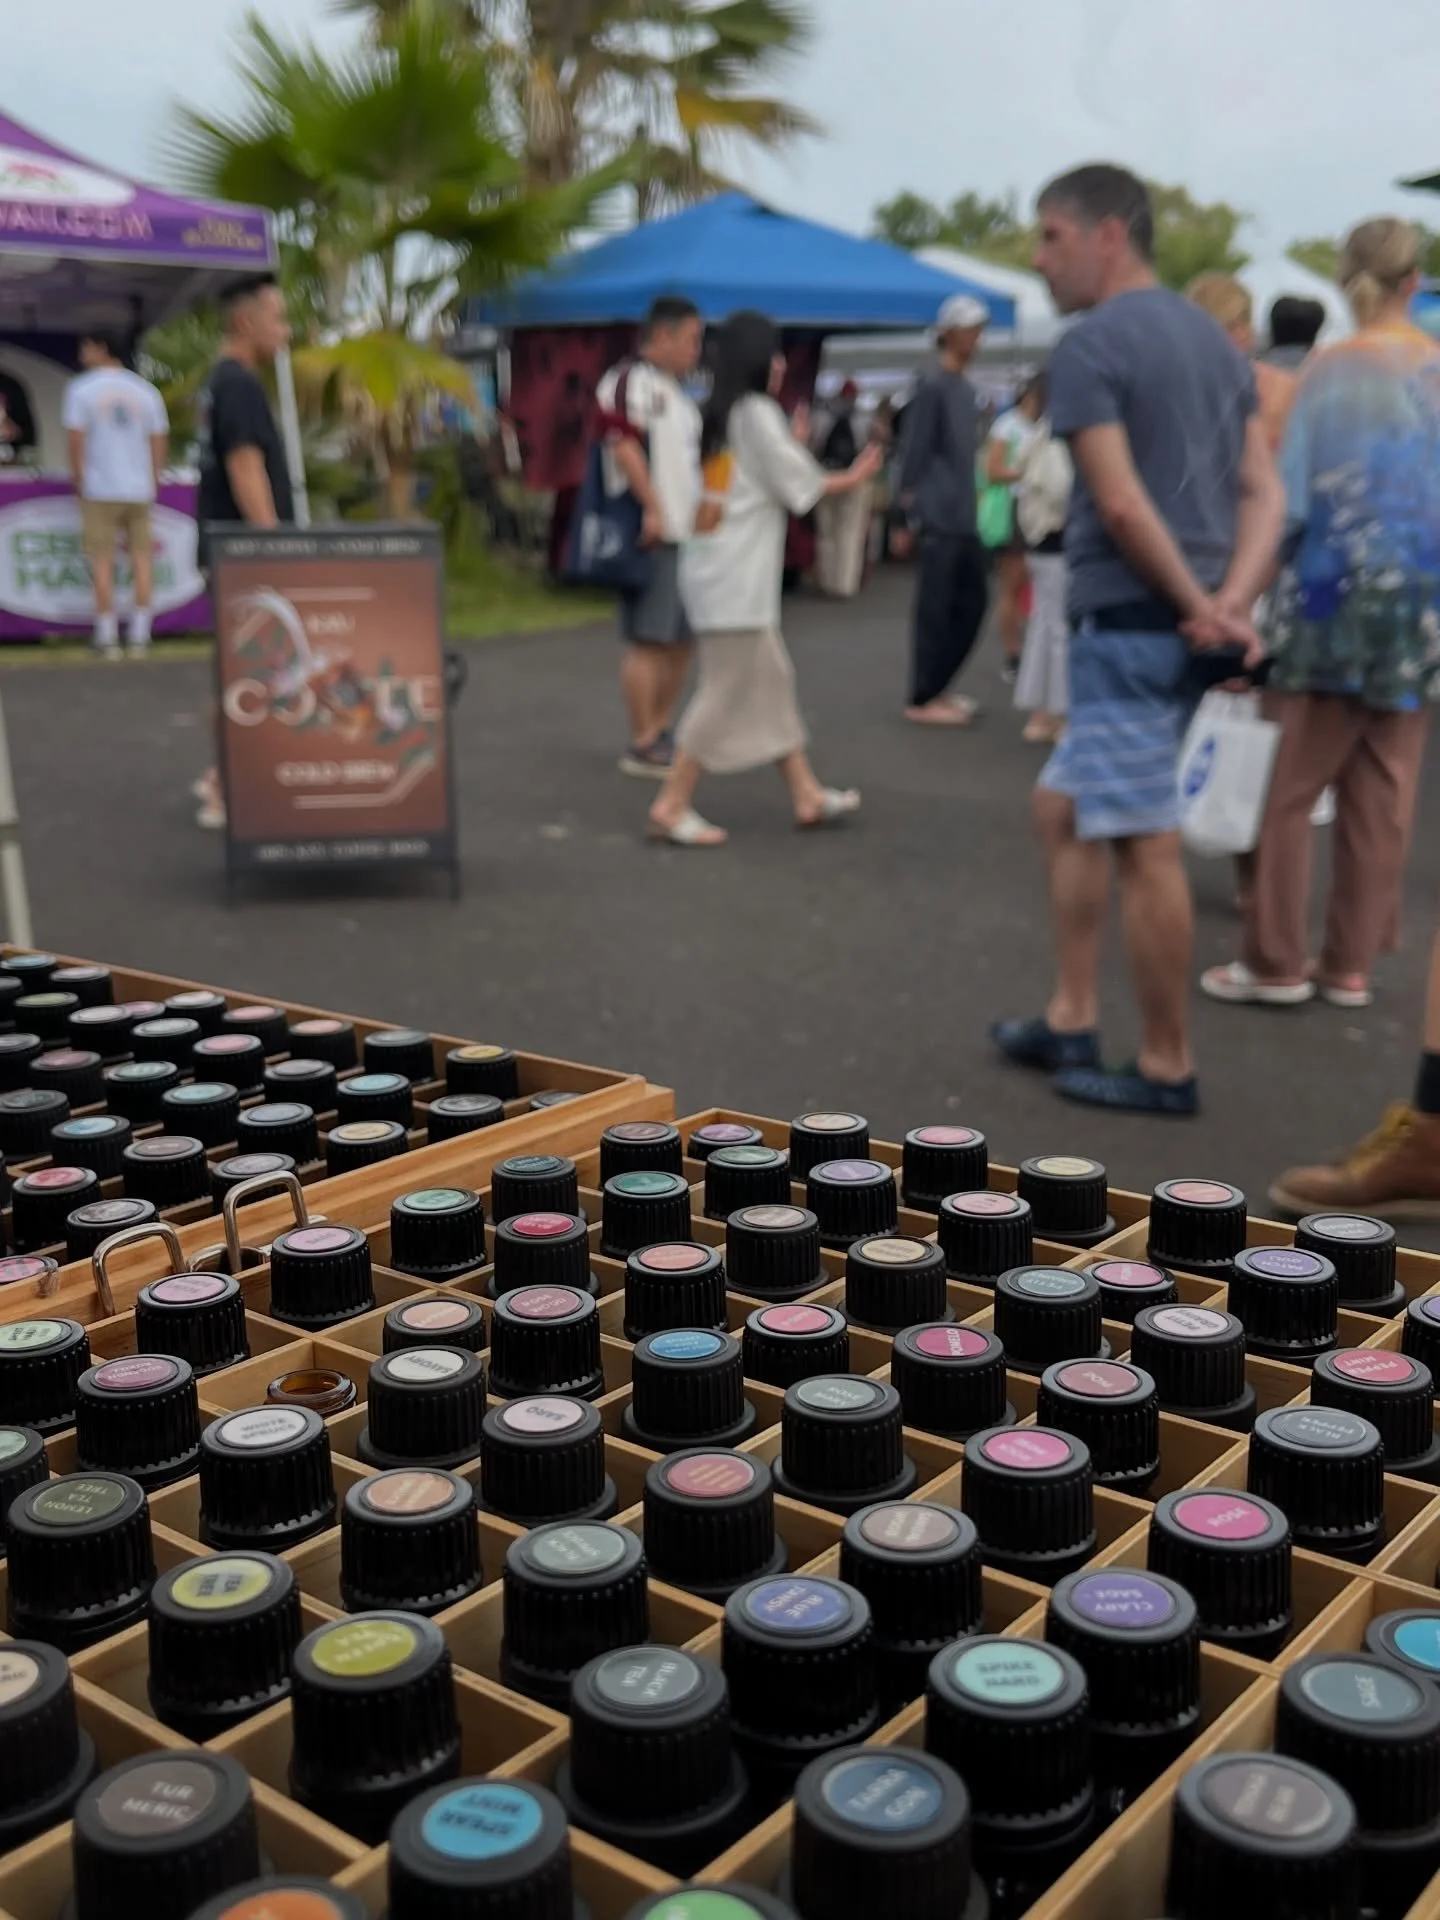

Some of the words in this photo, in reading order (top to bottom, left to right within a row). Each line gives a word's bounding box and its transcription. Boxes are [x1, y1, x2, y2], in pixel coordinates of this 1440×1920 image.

[946, 1328, 963, 1356] POMELO
[404, 1354, 455, 1375] SAVORY
[1344, 1355, 1377, 1367] MINT
[1345, 1361, 1398, 1376] PEPPER
[526, 1405, 570, 1422] SARO
[241, 1424, 297, 1440] SPRUCE
[242, 1418, 287, 1431] WHITE
[1298, 1422, 1342, 1440] BLACK
[1300, 1414, 1357, 1435] PEPPER
[68, 1493, 92, 1504] TEA
[77, 1483, 108, 1495] TREE
[44, 1500, 93, 1514] LEMON
[1206, 1506, 1250, 1528] ROSE
[546, 1539, 579, 1561] BLACK
[765, 1585, 805, 1612] TANSY
[1095, 1588, 1143, 1599] SAGE
[785, 1595, 824, 1618] BLUE
[1094, 1601, 1153, 1612] CLARY
[620, 1665, 648, 1687] TEA
[977, 1660, 1036, 1673] SPIKE
[642, 1661, 677, 1698] BLACK
[985, 1675, 1040, 1688] NARD
[1355, 1675, 1382, 1709] SAGE
[152, 1780, 194, 1799] TUR
[849, 1768, 908, 1811] TARRA
[121, 1797, 192, 1823] MERIC
[463, 1793, 524, 1814] MINT
[884, 1787, 928, 1819] GON
[438, 1808, 514, 1838] SPEAR
